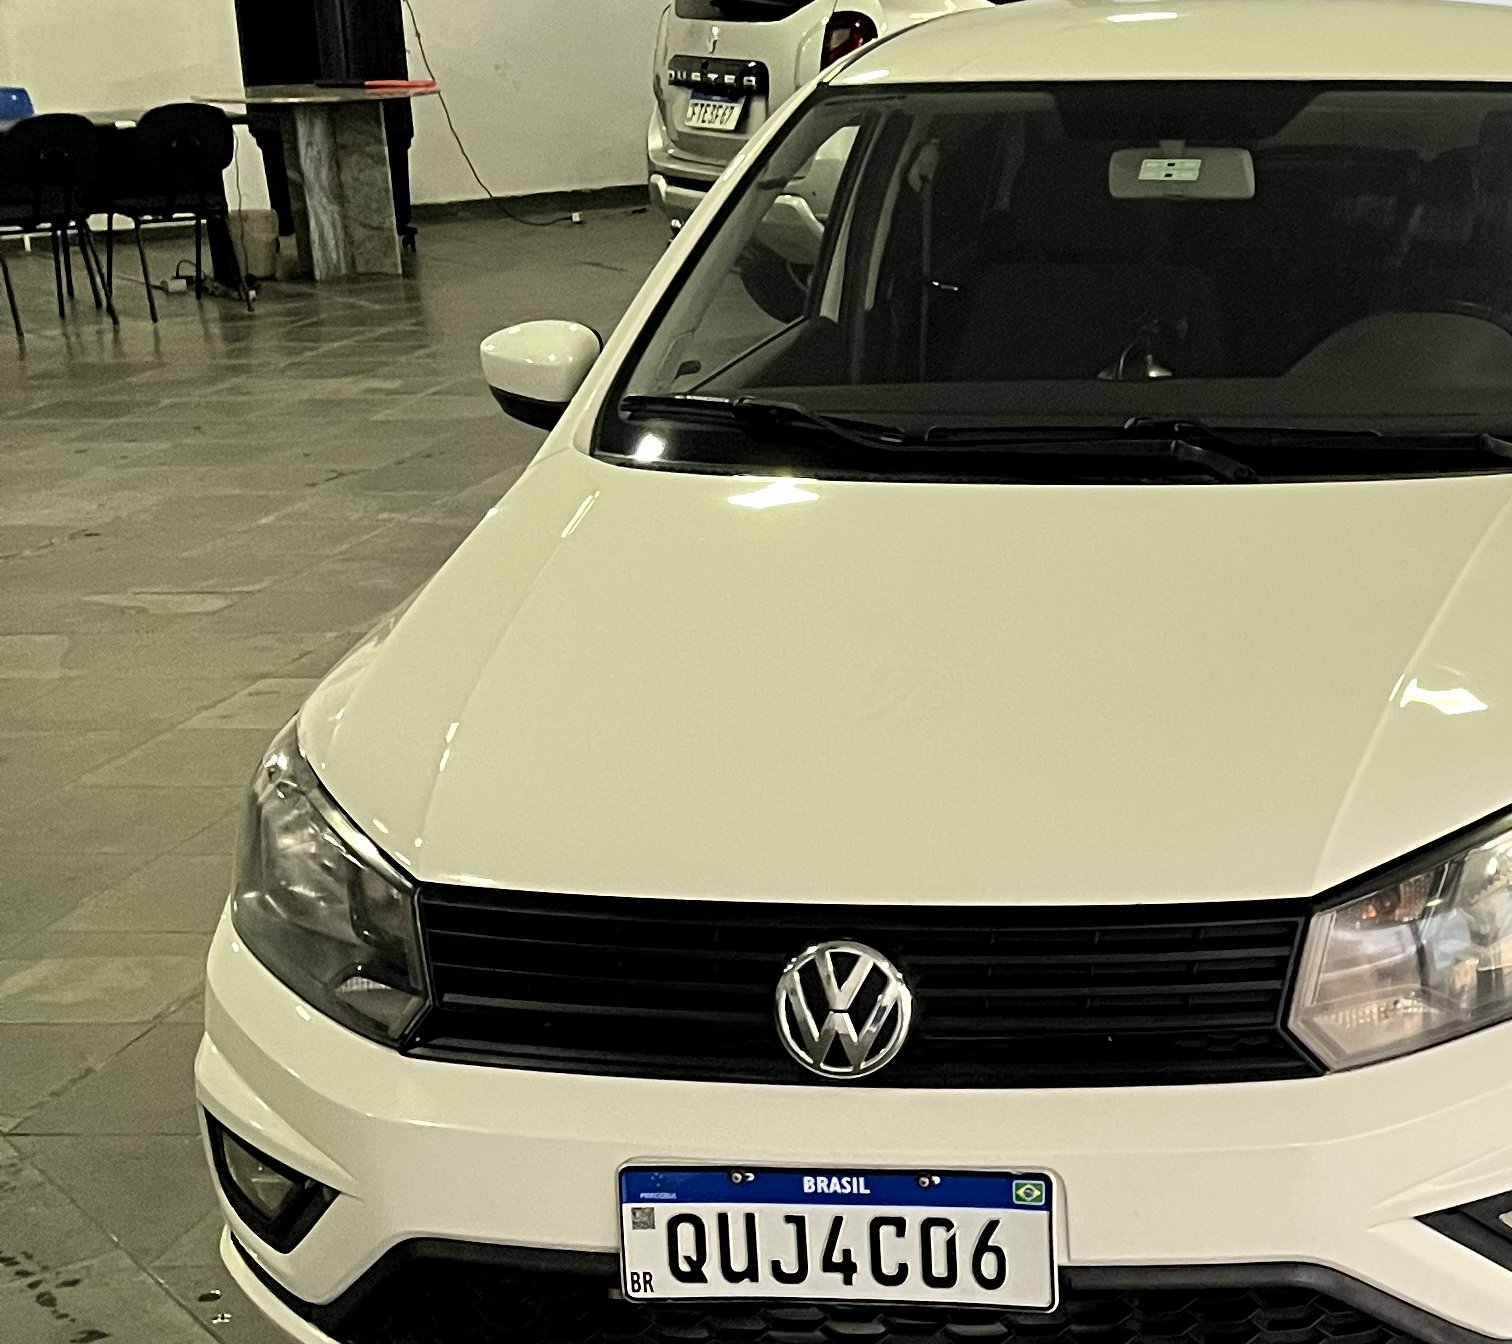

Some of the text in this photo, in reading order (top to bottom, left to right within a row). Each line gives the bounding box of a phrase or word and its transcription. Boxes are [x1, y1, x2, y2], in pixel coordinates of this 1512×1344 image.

[667, 70, 756, 87] DUSTER
[803, 1176, 870, 1195] BRASIL
[667, 1212, 1008, 1291] QUJ4C06
[630, 1271, 655, 1293] BR
